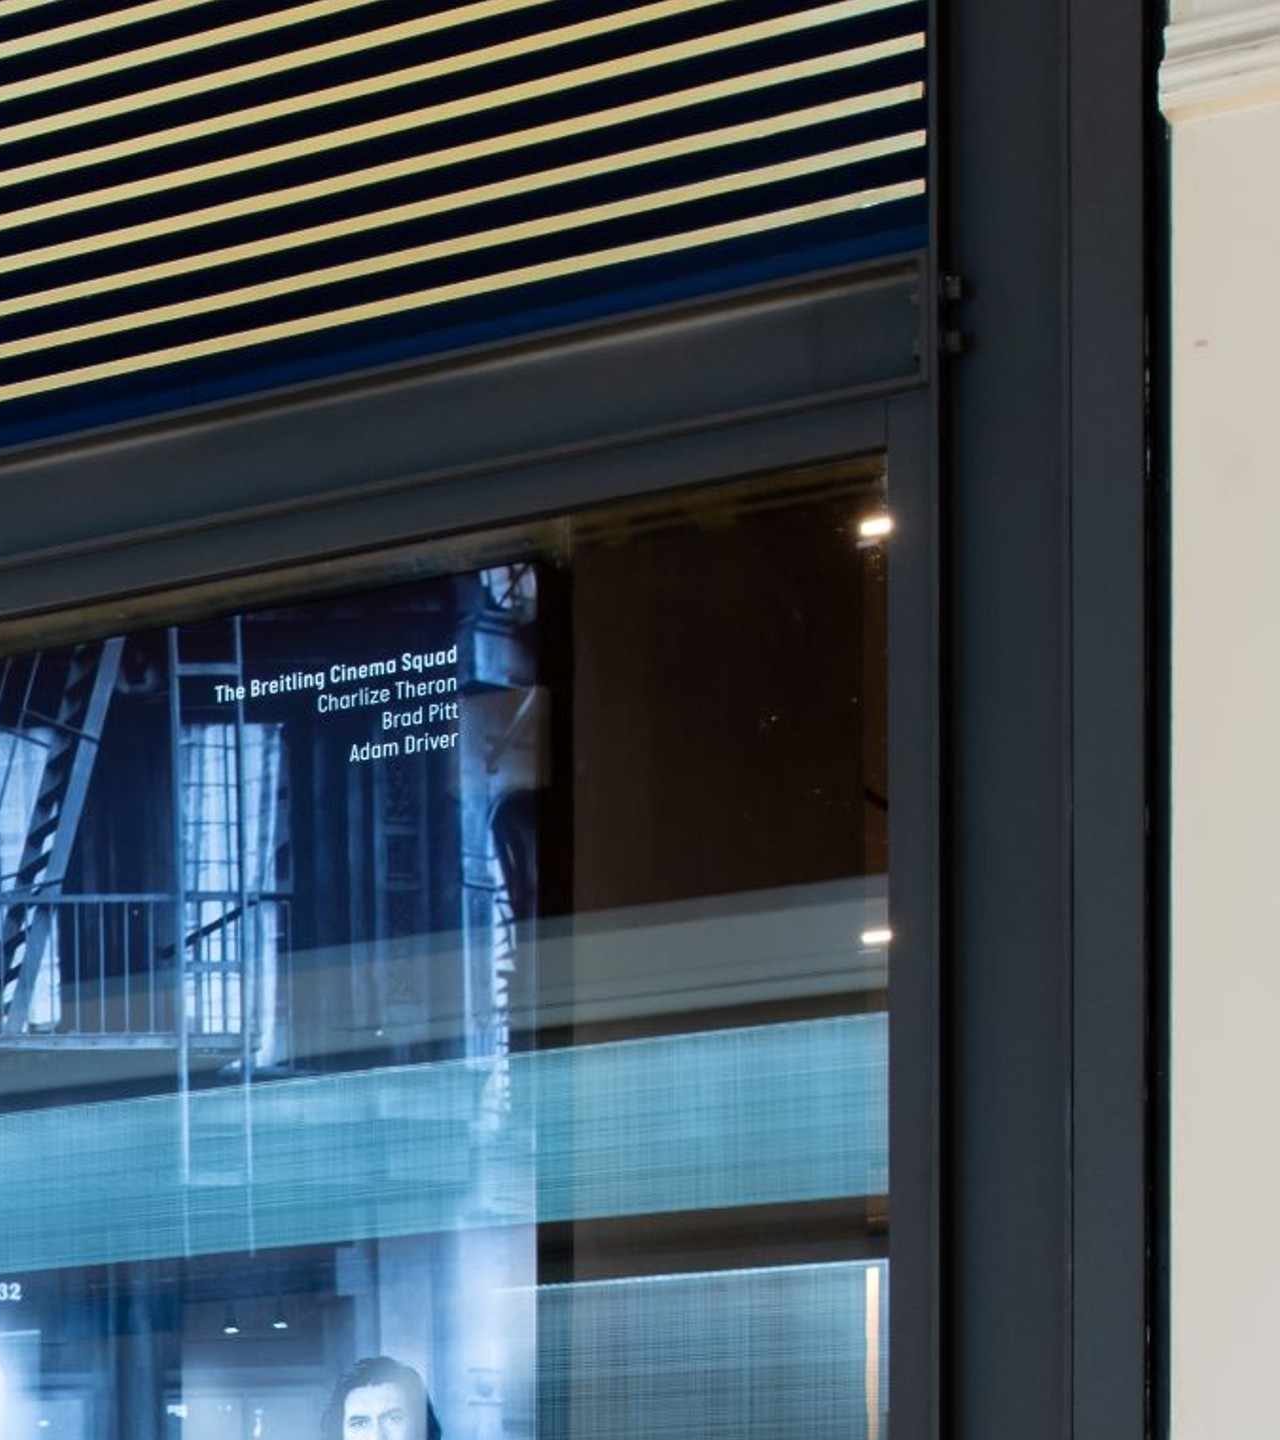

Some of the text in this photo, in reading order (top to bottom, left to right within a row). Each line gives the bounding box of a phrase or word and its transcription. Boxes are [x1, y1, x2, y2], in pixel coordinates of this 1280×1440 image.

[215, 645, 458, 703] The Breitling Cinema Squad
[317, 677, 458, 714] Charlize Theron
[382, 703, 459, 730] Brad Pitt
[349, 732, 458, 763] Adam Driver
